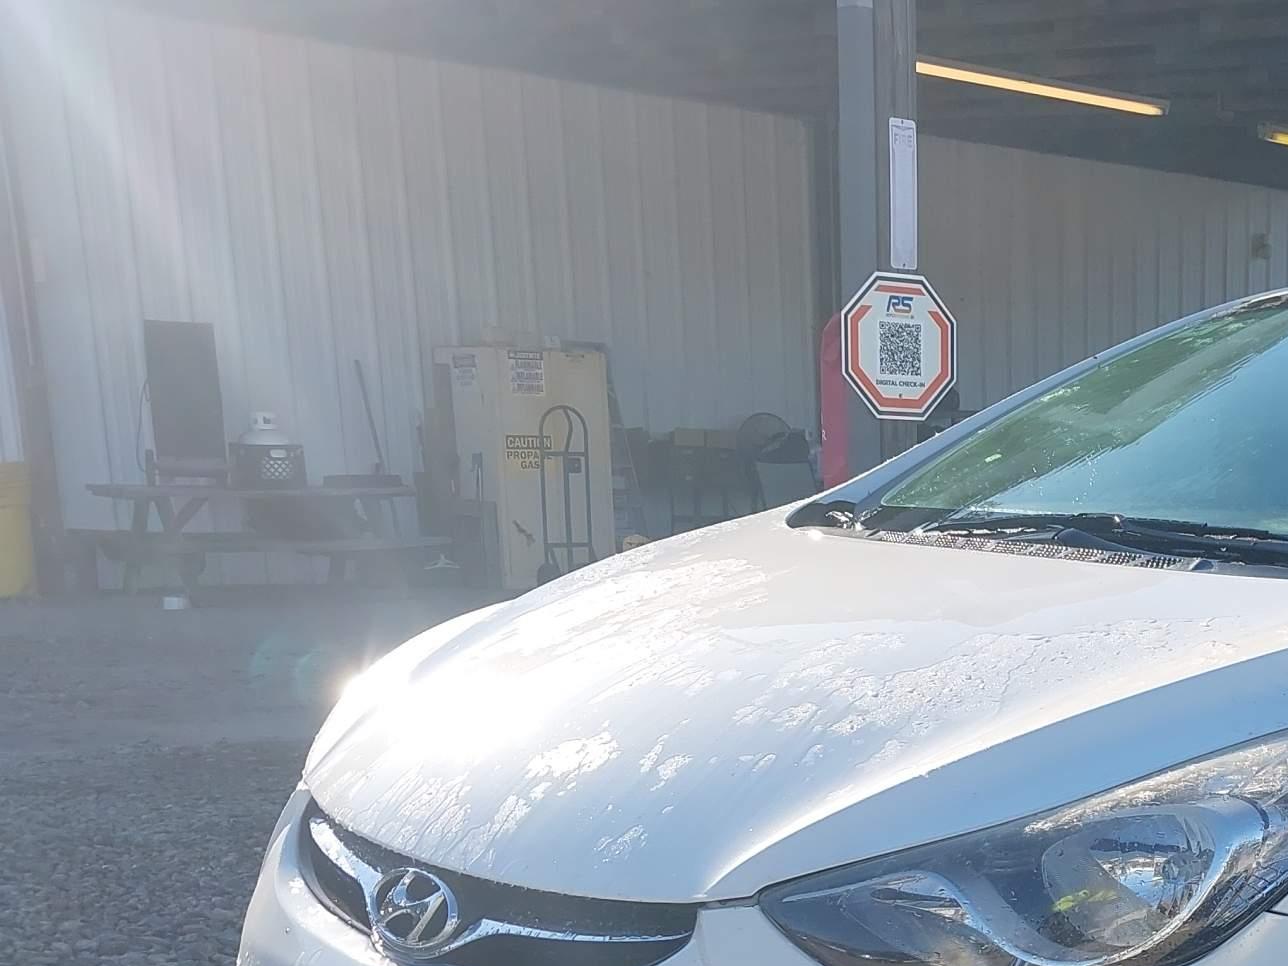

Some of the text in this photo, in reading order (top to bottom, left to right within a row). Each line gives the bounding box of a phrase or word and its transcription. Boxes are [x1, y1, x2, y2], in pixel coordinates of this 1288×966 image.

[875, 379, 926, 388] DIGITAL CHECK-IN
[507, 436, 551, 448] CAUTIN
